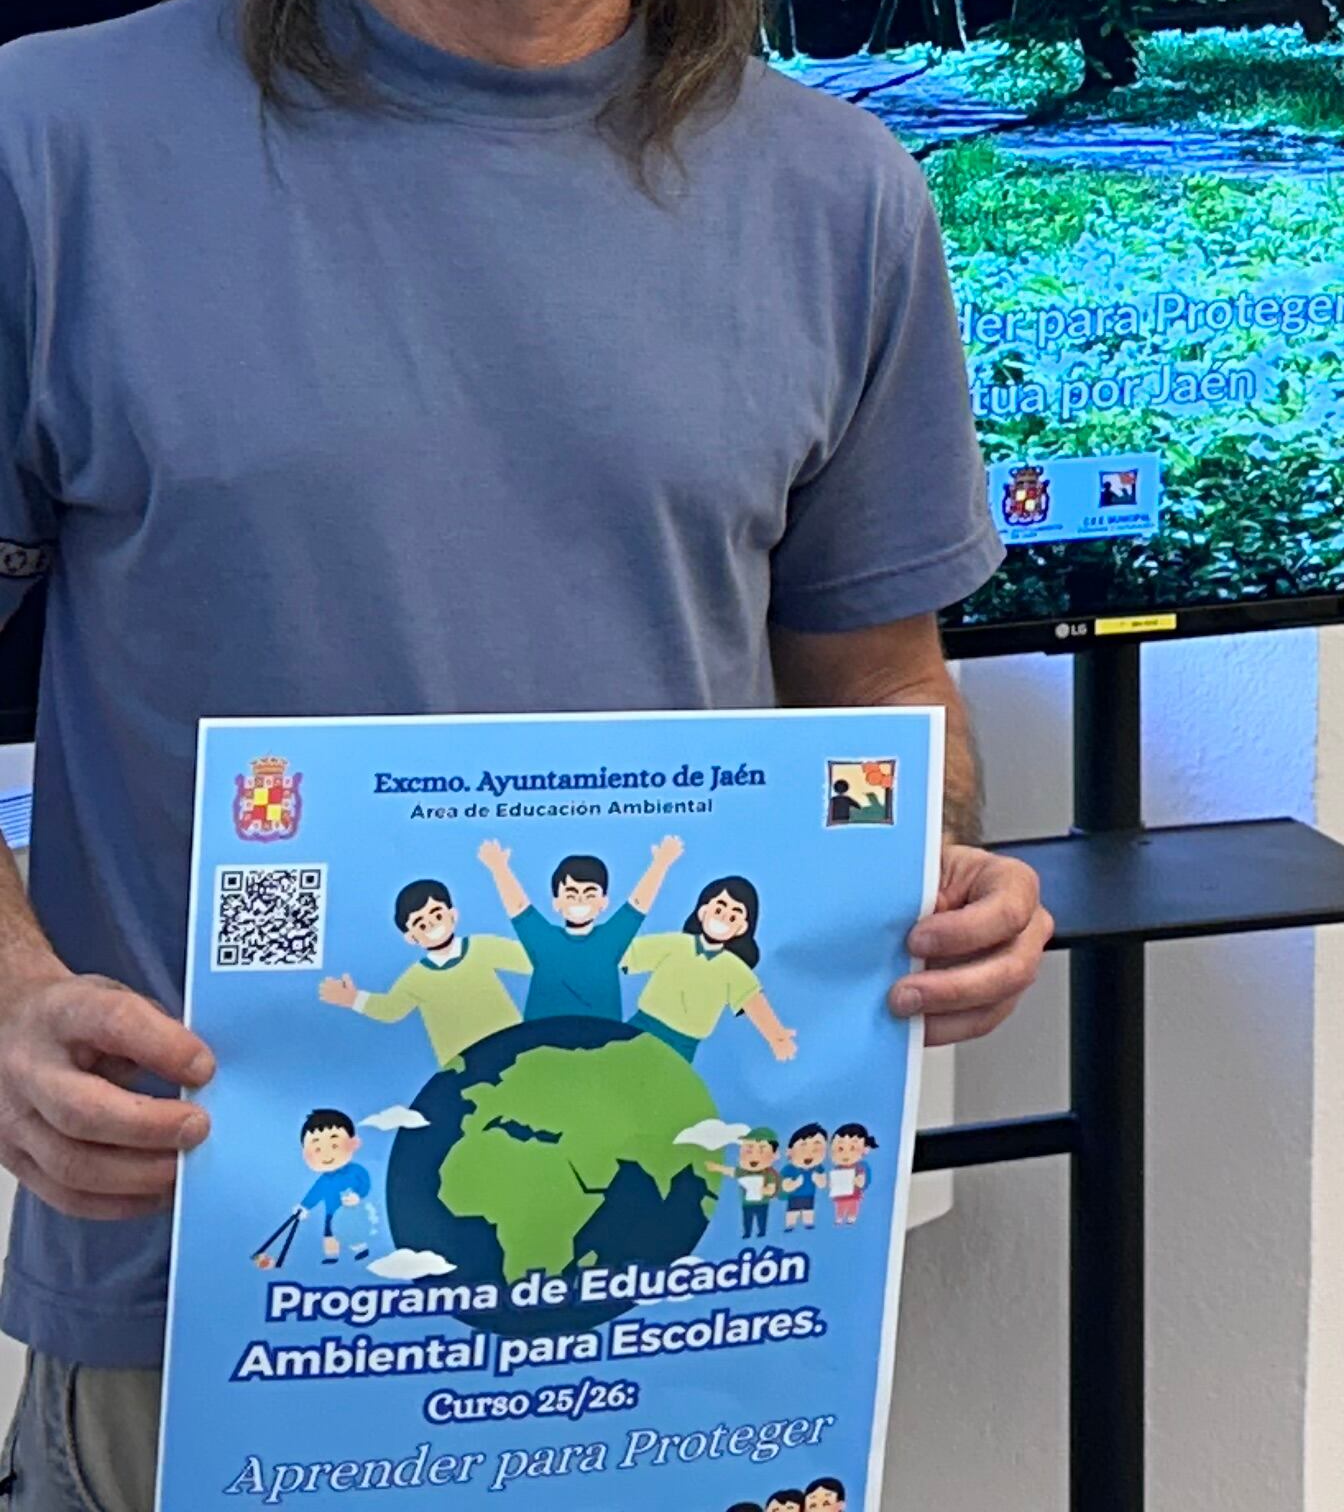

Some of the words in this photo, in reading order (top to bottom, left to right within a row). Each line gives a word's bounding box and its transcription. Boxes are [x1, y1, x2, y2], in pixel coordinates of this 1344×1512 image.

[1038, 306, 1138, 348] para
[1060, 377, 1142, 420] por
[1151, 360, 1256, 404] Jaén
[373, 772, 470, 794] Excmo.
[477, 766, 667, 797] Ayuntamiento
[672, 764, 704, 788] de
[709, 763, 767, 791] Jaén
[464, 802, 489, 818] de
[496, 800, 601, 818] Educación
[608, 798, 713, 815] Ambiental
[270, 1284, 498, 1324] Programa
[511, 1272, 568, 1306] de
[581, 1251, 807, 1301] Educación
[238, 1334, 485, 1378] Ambiental
[500, 1331, 599, 1374] para
[611, 1310, 825, 1356] Escolares.
[426, 1390, 529, 1422] Curso
[538, 1381, 637, 1420] 25/26:
[230, 1443, 485, 1504] Aprender
[491, 1435, 608, 1489] para
[618, 1413, 836, 1469] Proteger
